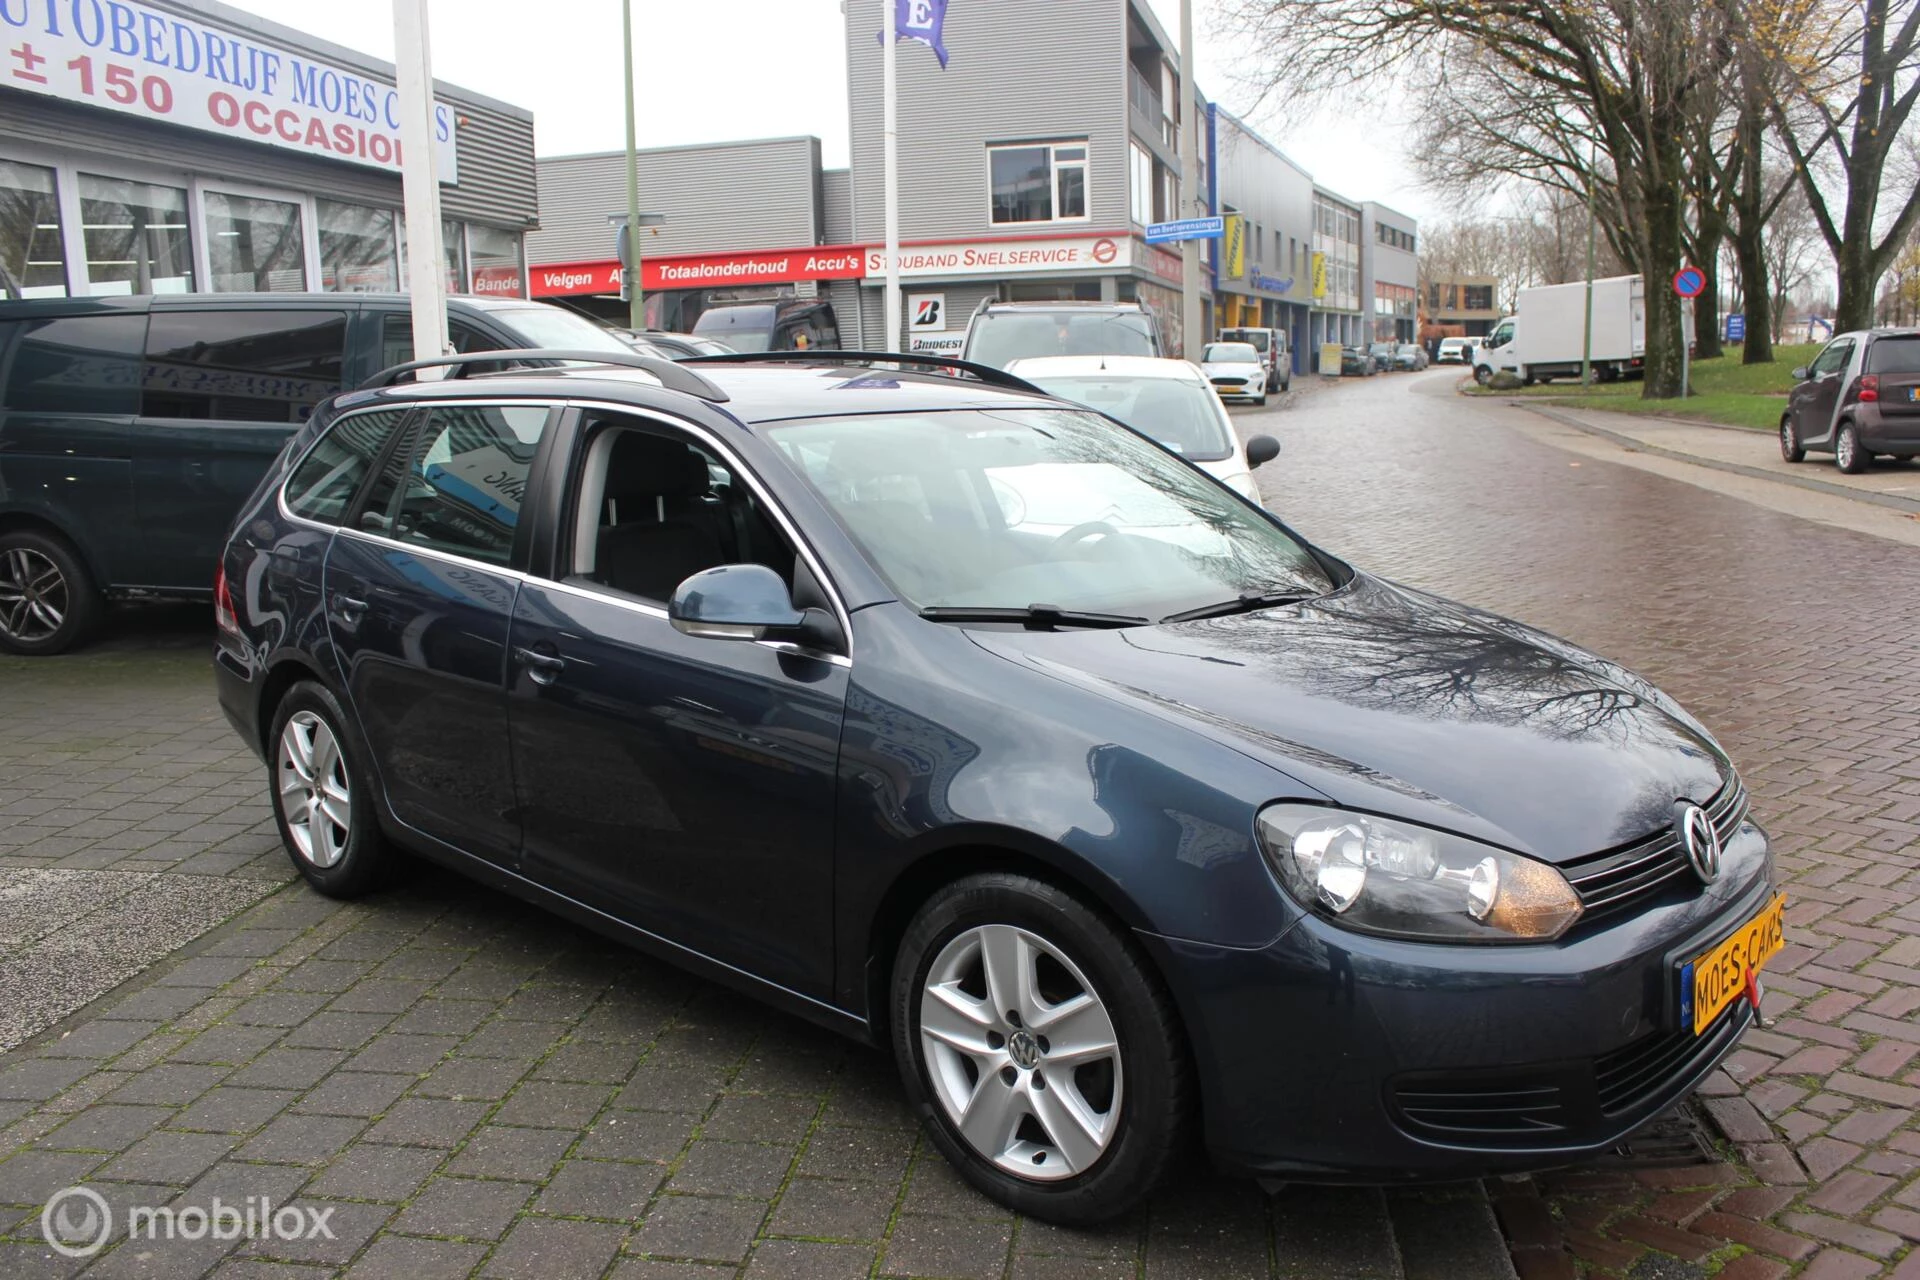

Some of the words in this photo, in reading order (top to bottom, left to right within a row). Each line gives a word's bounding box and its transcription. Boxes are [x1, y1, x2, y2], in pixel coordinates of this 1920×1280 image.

[67, 55, 173, 114] 150
[291, 60, 377, 124] MOES
[963, 248, 1079, 266] SNELSERVICE
[475, 276, 520, 292] Bande
[543, 272, 593, 288] Velgen
[660, 258, 788, 280] Totaalonderhoud
[804, 255, 859, 272] Accu's
[912, 339, 964, 351] BRIDGEST
